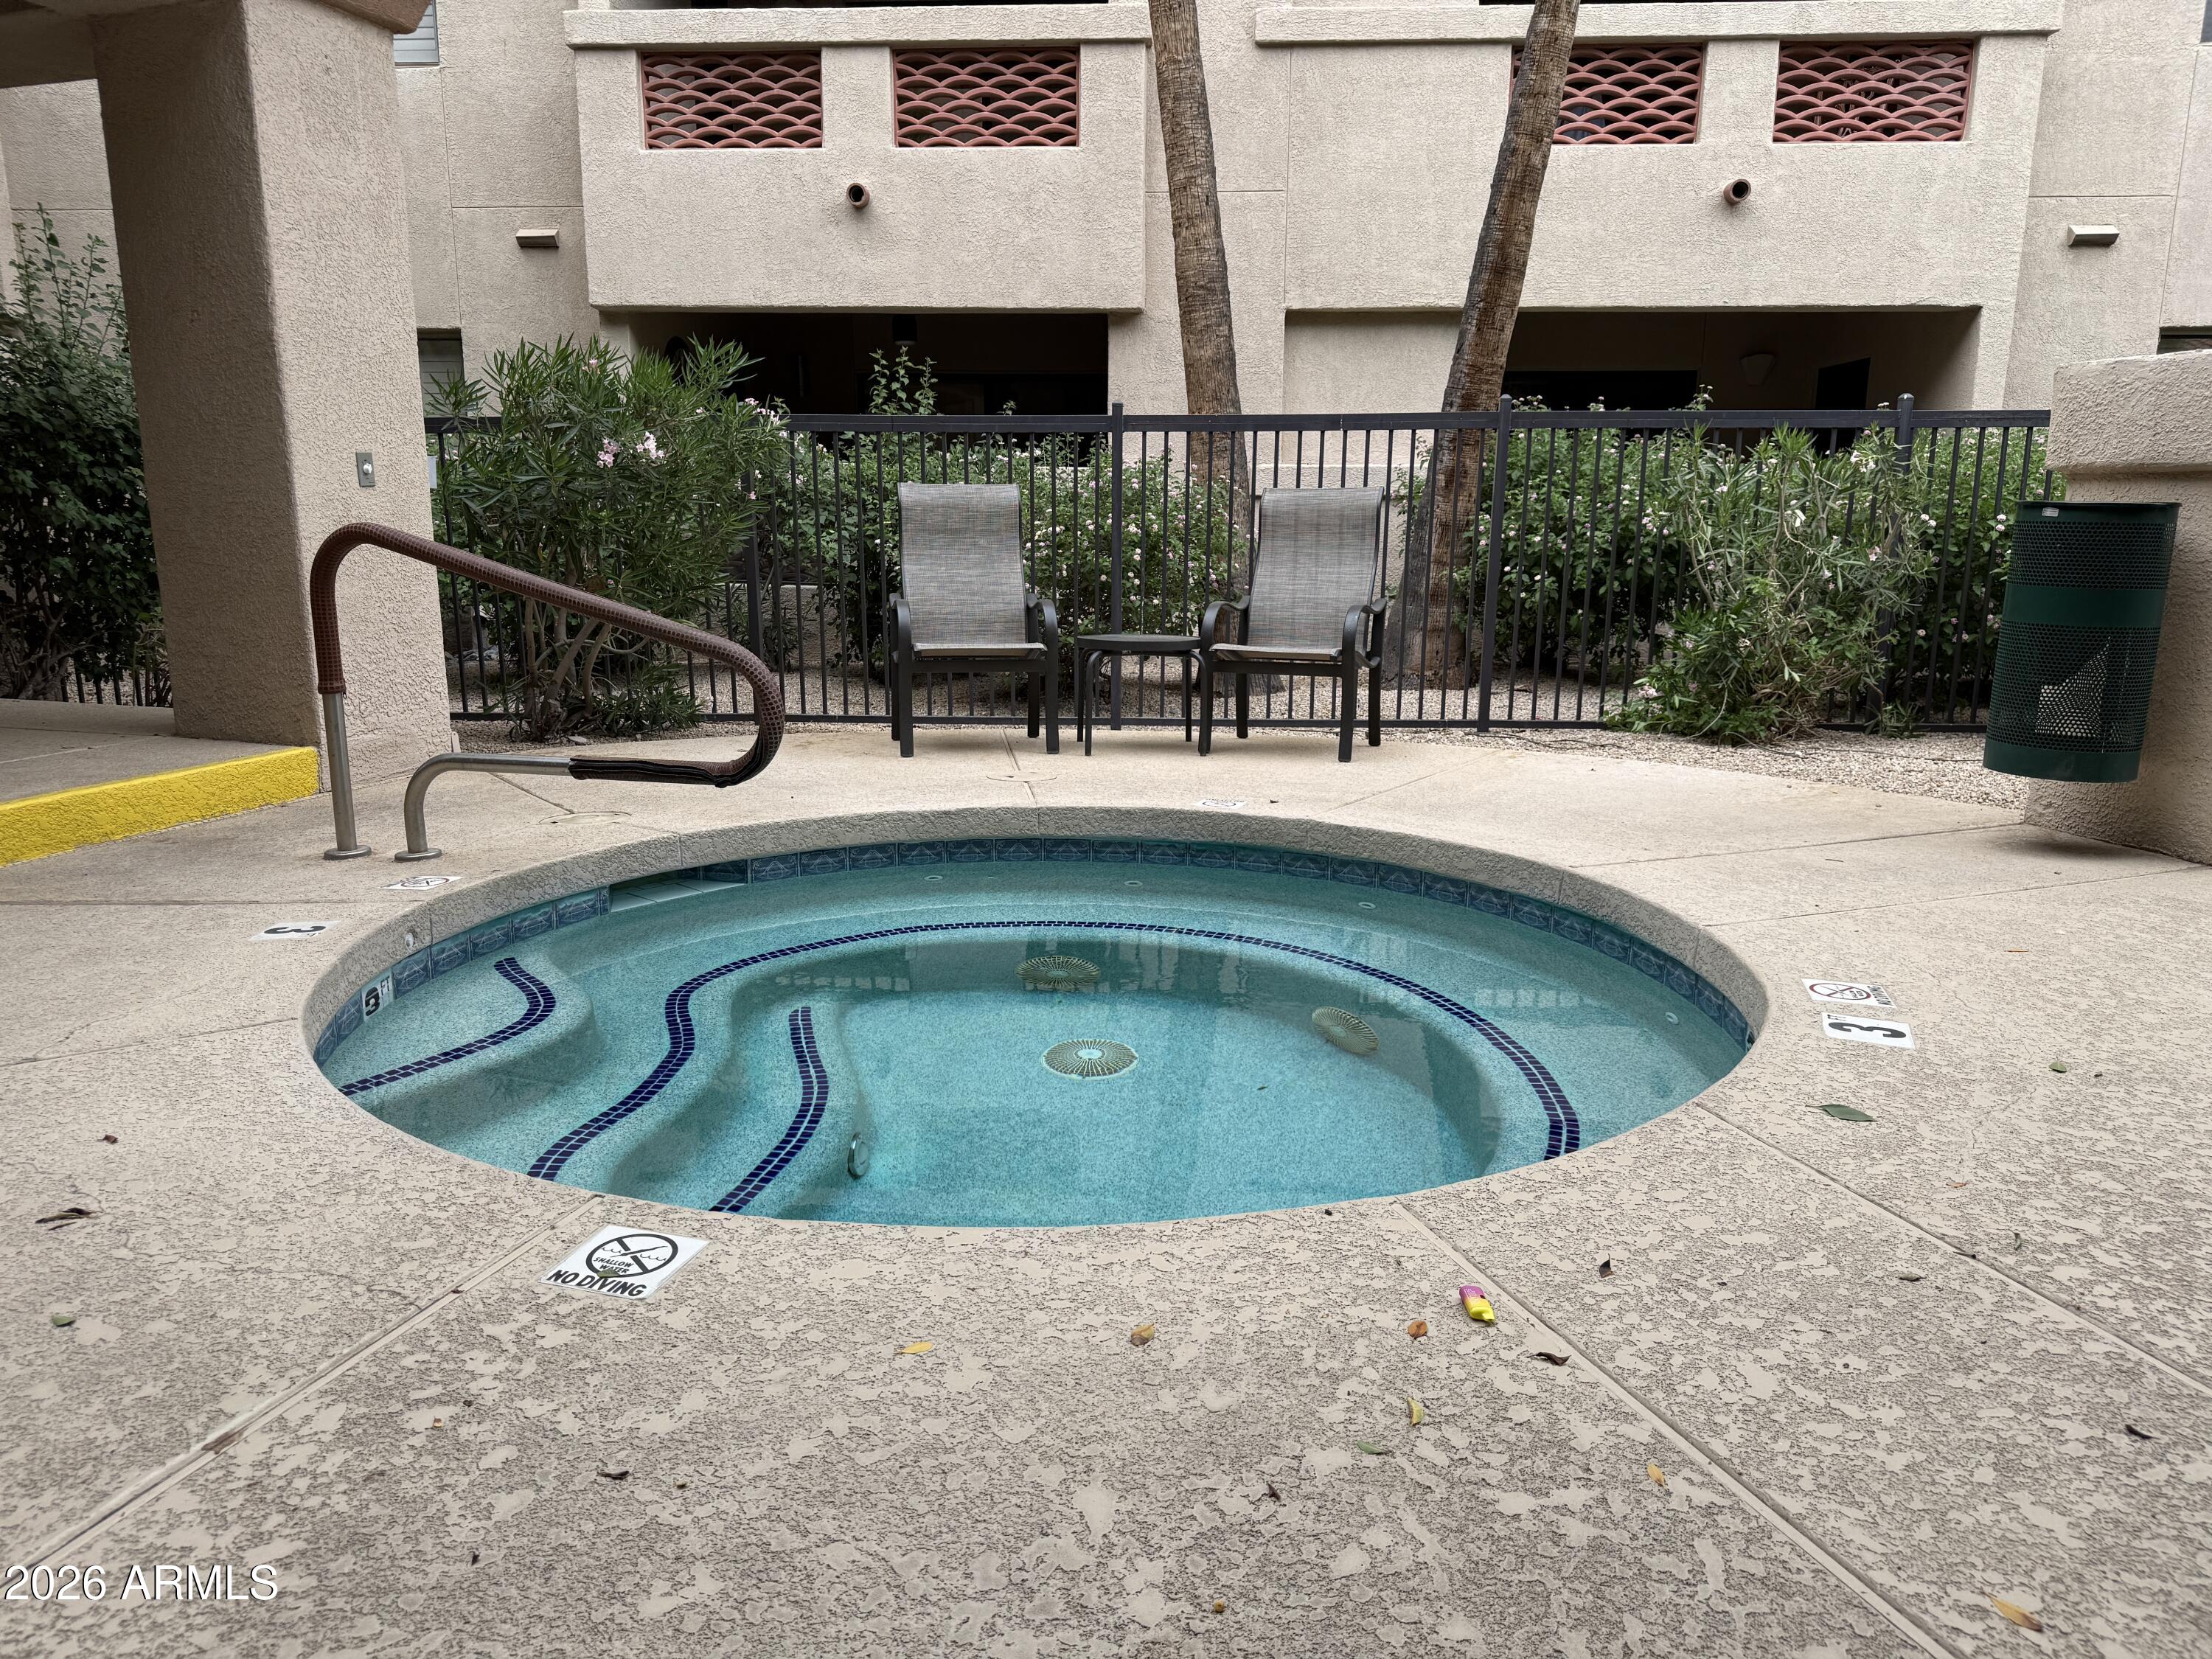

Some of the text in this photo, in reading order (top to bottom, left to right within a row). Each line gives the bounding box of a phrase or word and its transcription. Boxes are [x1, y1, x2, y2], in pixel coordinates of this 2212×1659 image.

[264, 925, 326, 934] 3
[380, 975, 390, 996] FT
[1829, 1022, 1907, 1038] 3
[593, 1256, 634, 1267] SHALLOW
[546, 1270, 647, 1296] NO DIVING
